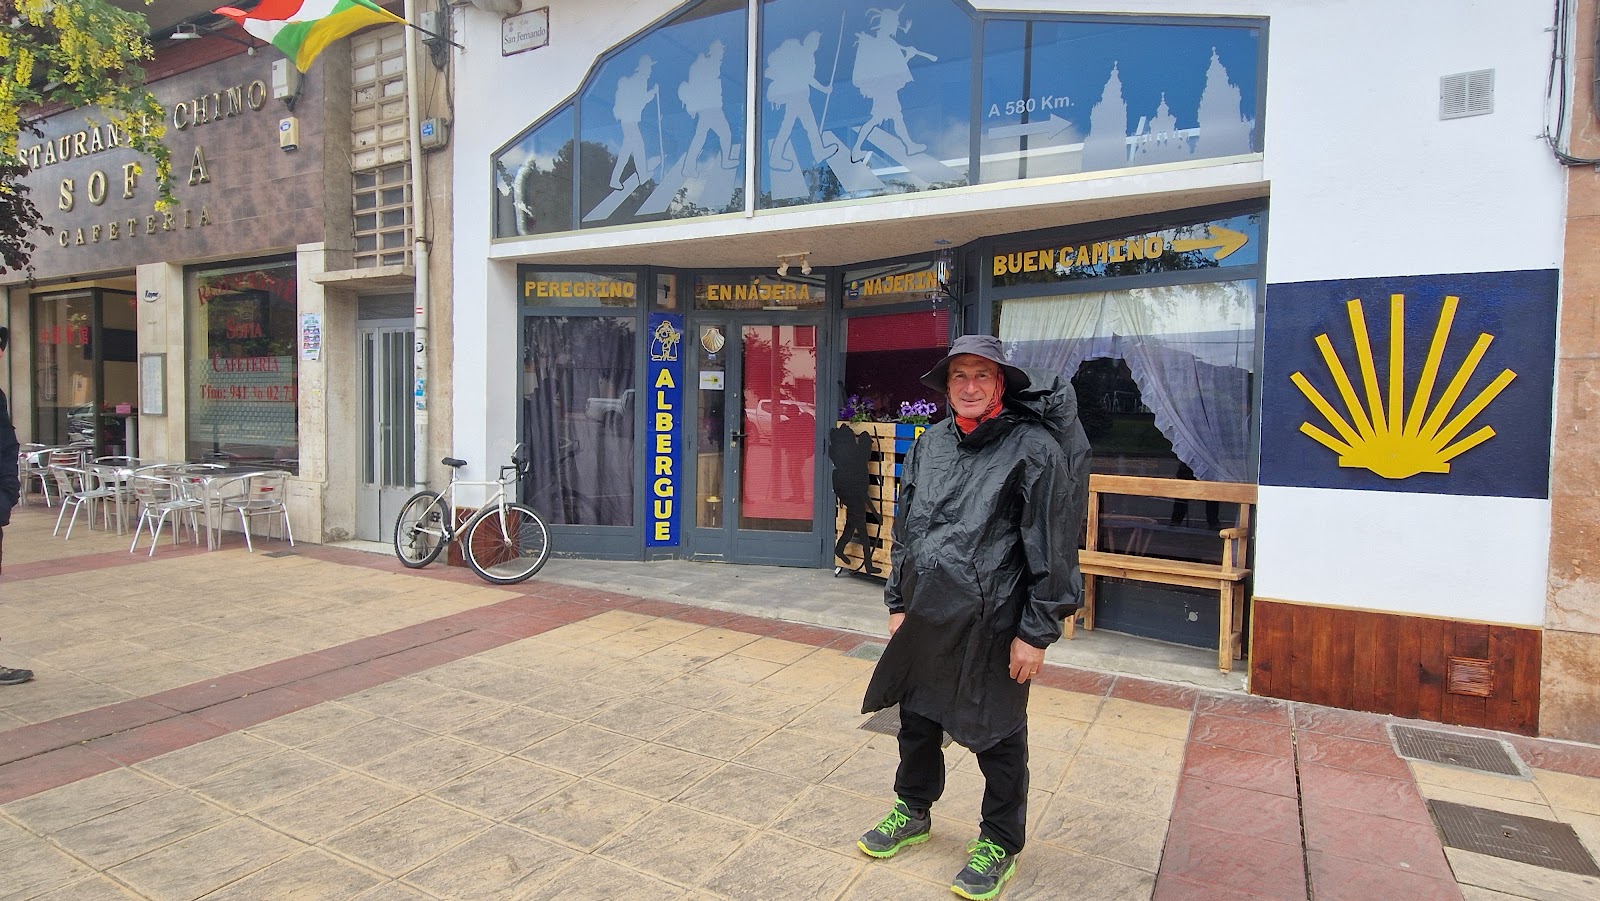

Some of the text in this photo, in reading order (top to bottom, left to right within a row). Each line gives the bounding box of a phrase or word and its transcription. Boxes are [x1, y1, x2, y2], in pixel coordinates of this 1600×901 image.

[504, 27, 546, 44] San Fernando
[173, 79, 267, 131] CHINO
[988, 94, 1075, 118] A 580 Km.
[58, 145, 210, 213] SOFA
[59, 204, 212, 248] CAFETERIA
[993, 236, 1164, 277] BUEN CAMINO
[524, 281, 635, 298] PEREGRINO
[707, 279, 810, 301] EN NÁJERA
[200, 385, 226, 399] Tfno:
[229, 385, 247, 400] 941
[266, 385, 279, 401] 02
[653, 368, 676, 541] ALBERGUE
